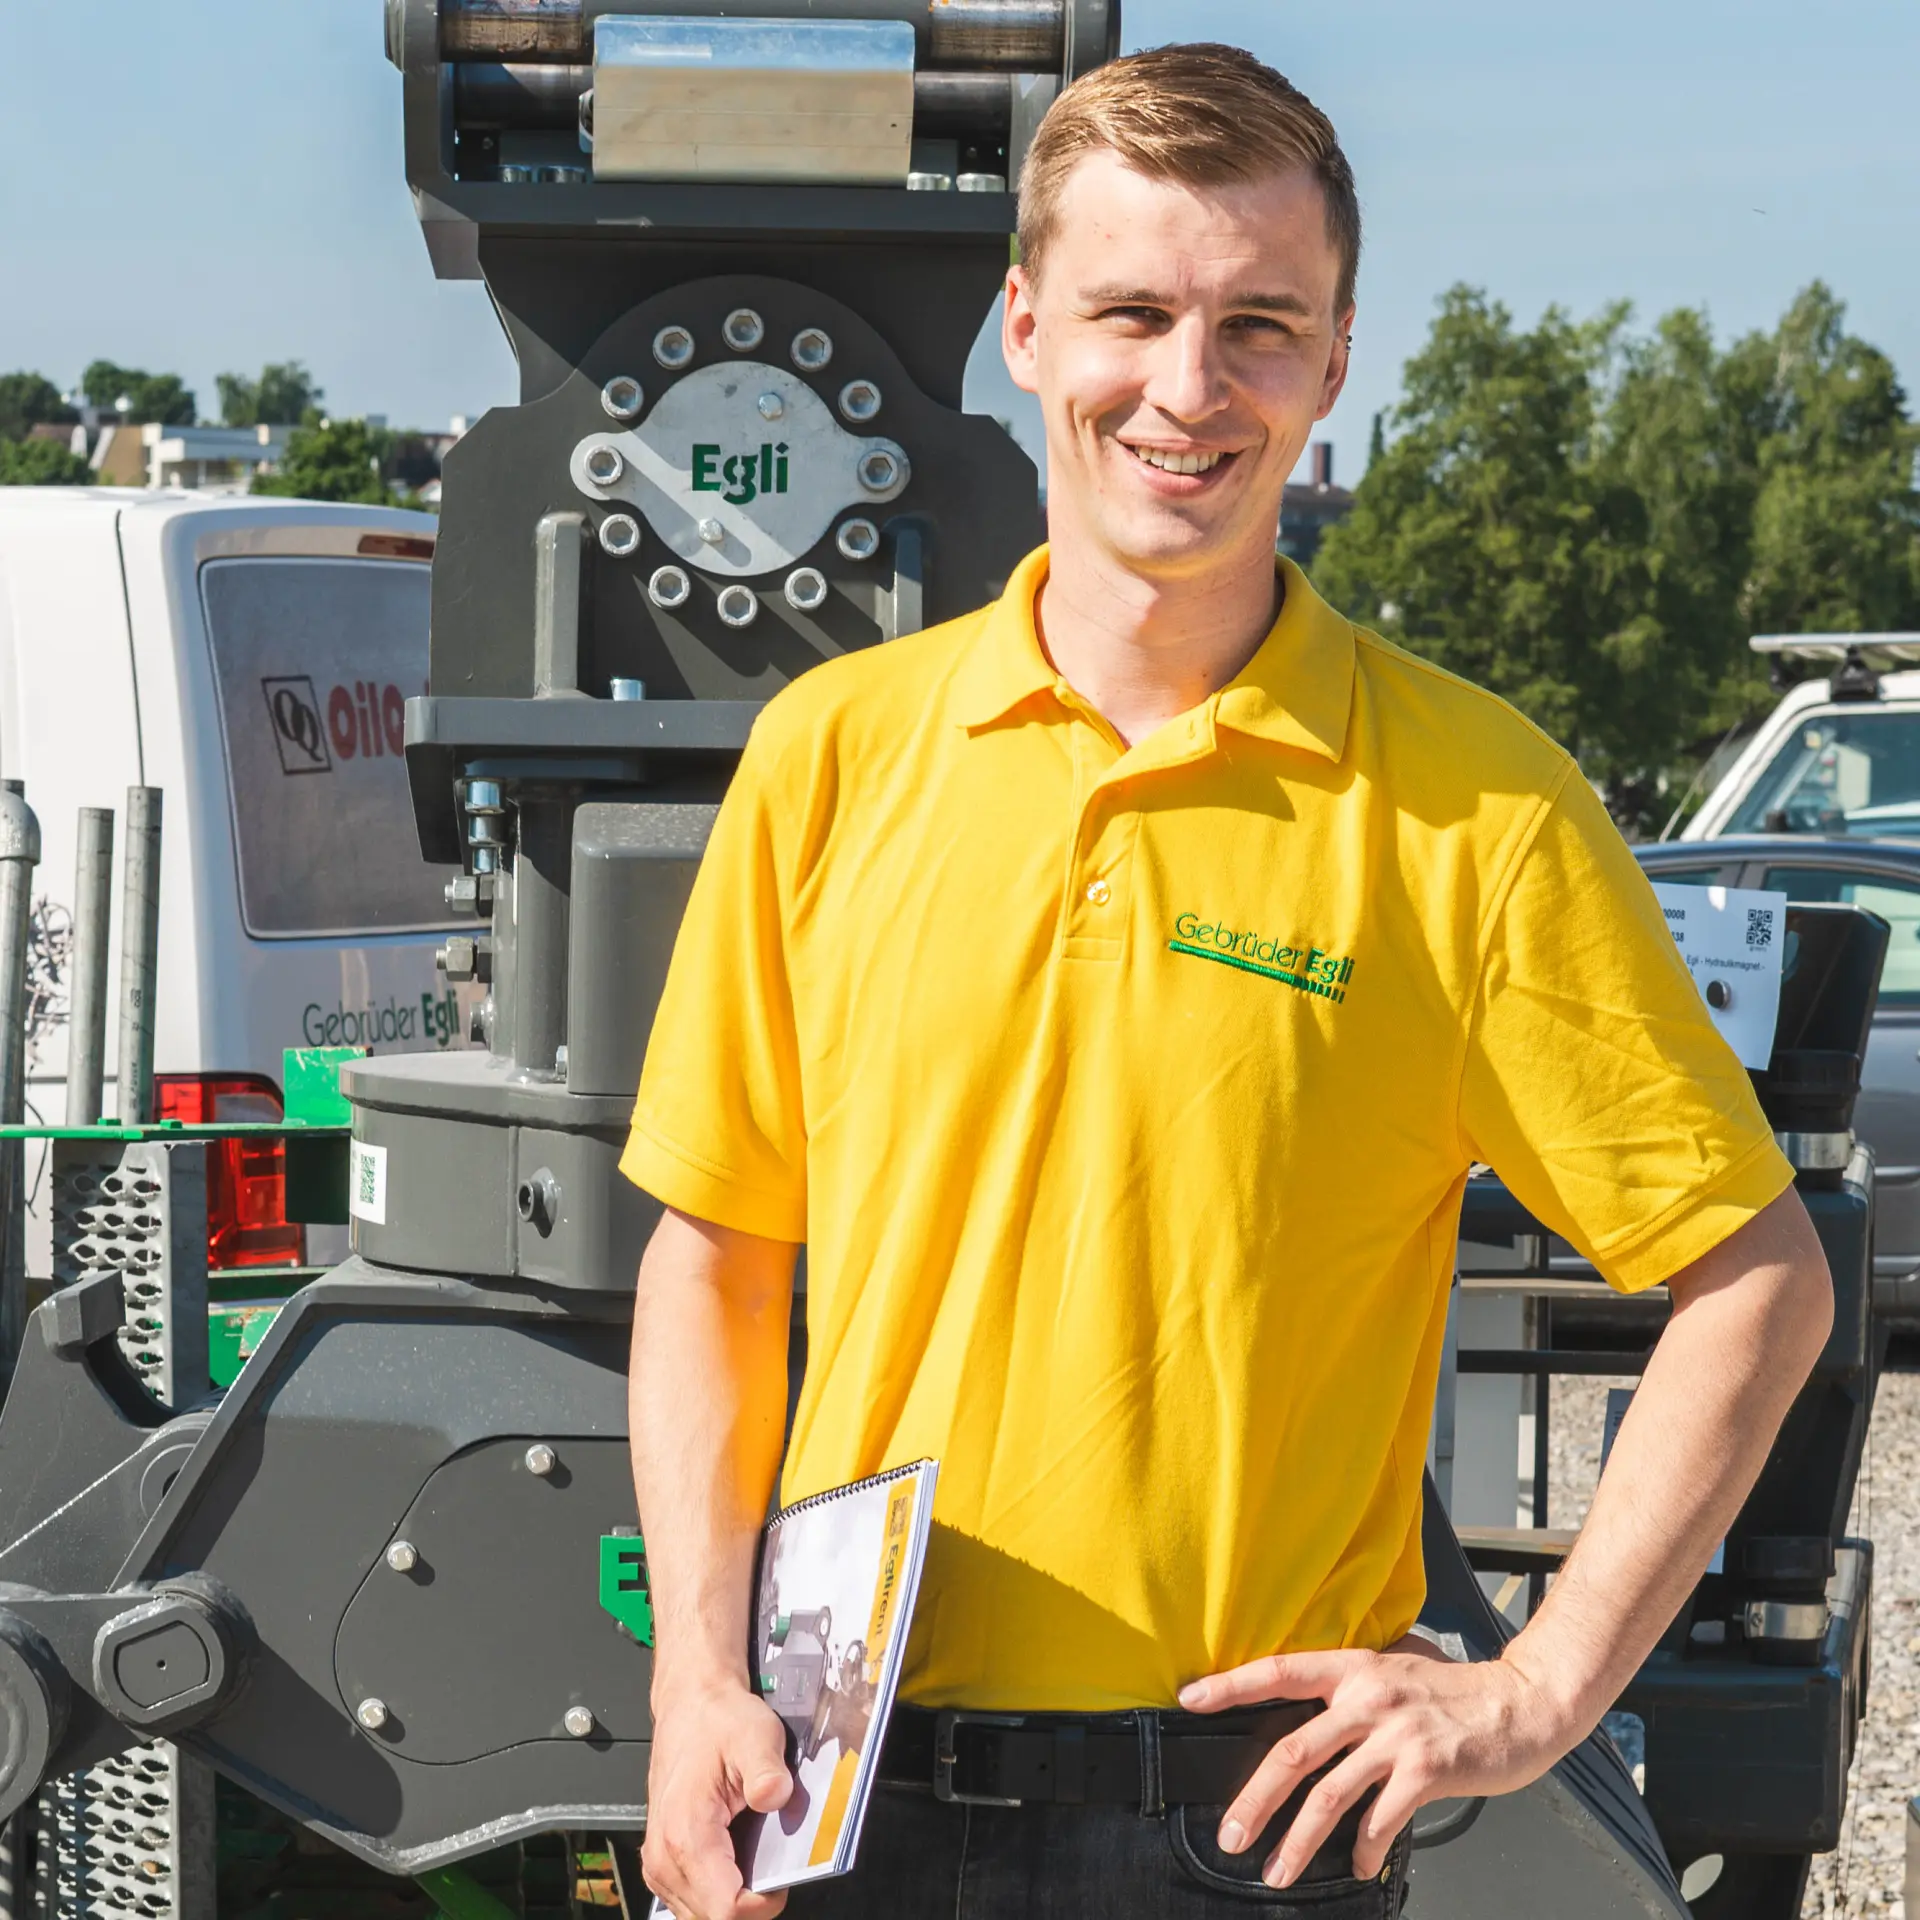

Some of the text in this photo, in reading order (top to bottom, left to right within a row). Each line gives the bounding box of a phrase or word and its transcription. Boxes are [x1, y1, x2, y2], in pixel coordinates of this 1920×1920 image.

[692, 442, 789, 505] Egli
[1175, 912, 1356, 985] Gebrüder Egli
[302, 988, 460, 1048] Gebrüder Egli
